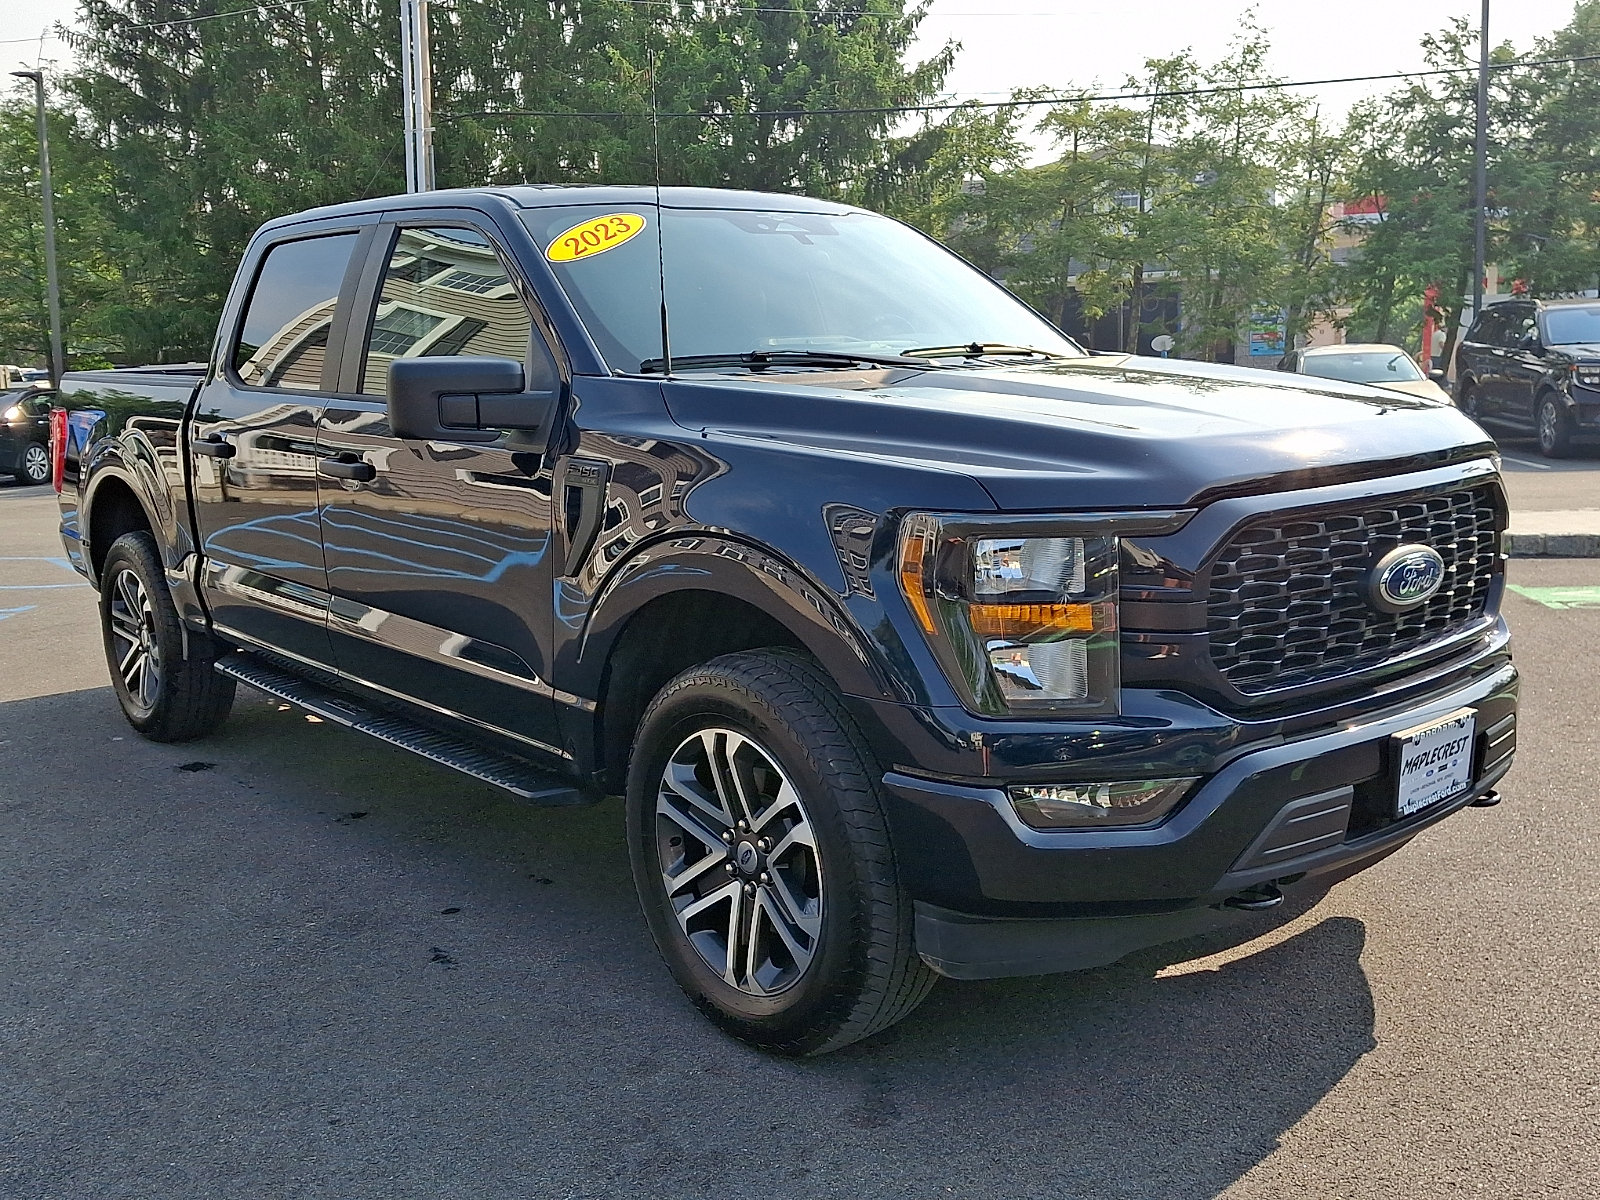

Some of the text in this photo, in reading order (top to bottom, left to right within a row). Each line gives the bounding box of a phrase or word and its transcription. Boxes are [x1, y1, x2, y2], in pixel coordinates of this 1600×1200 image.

[564, 217, 631, 256] 2023
[1399, 563, 1435, 595] Ford
[1401, 735, 1470, 777] MAPLECREST
